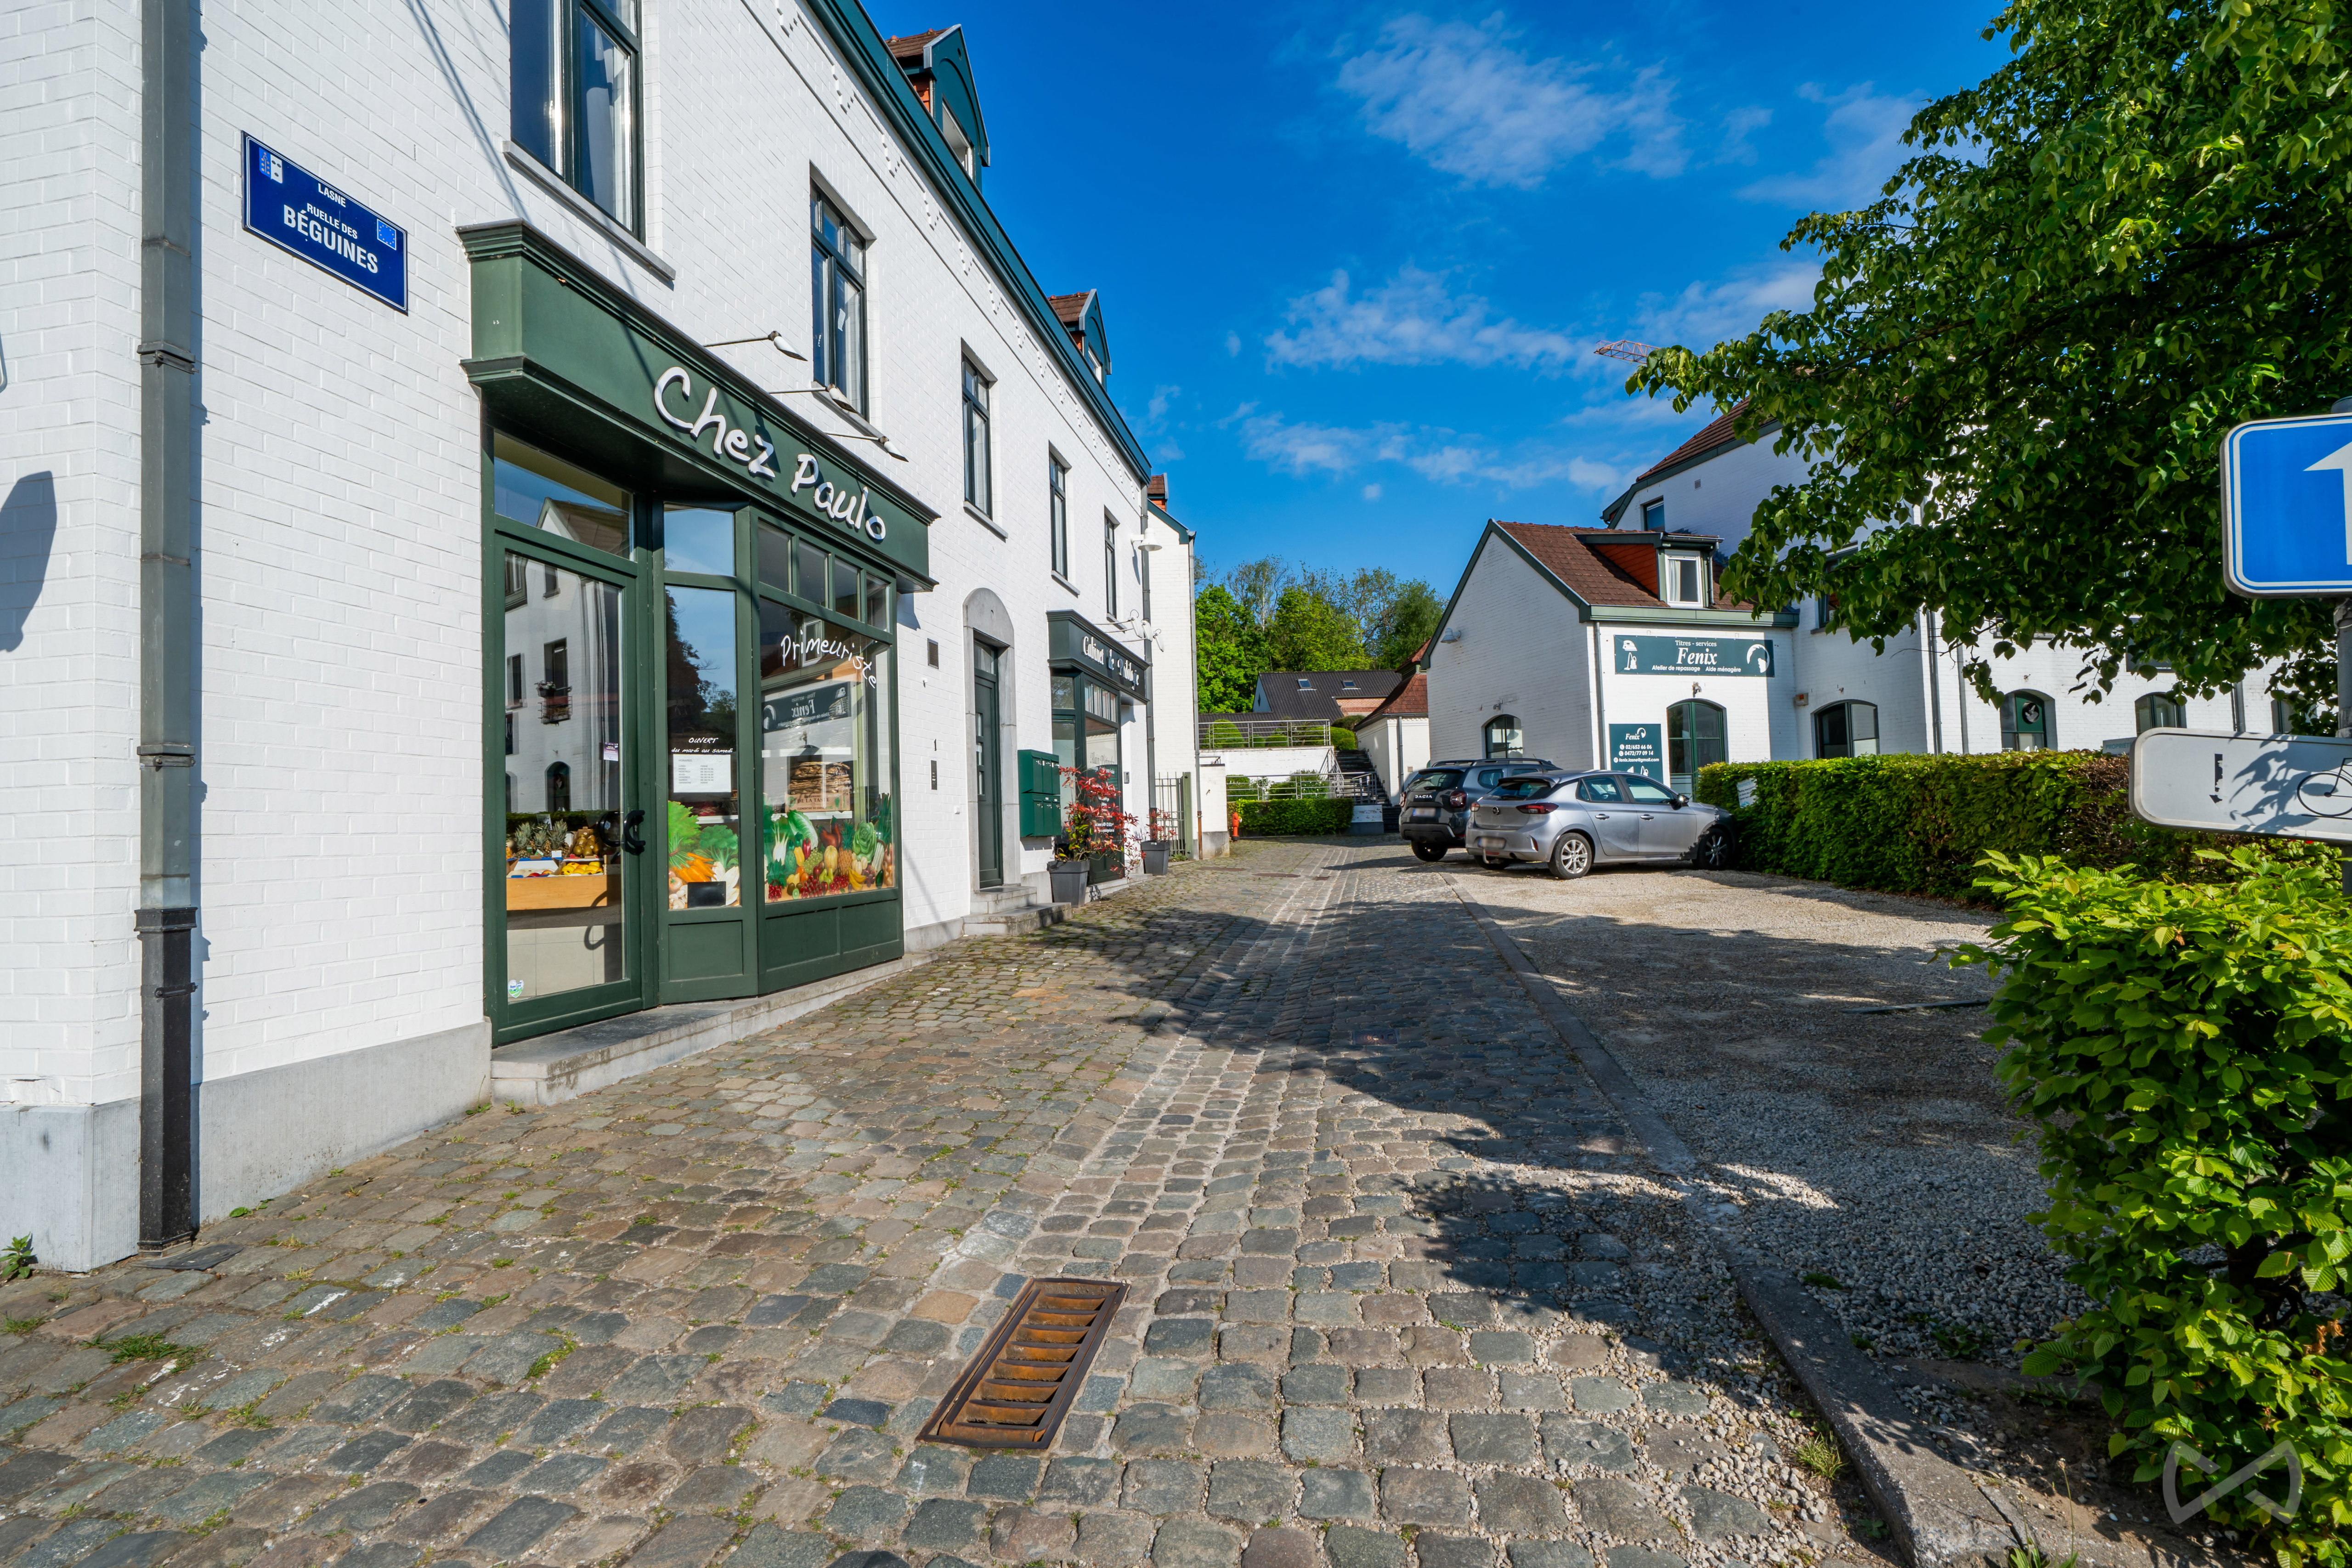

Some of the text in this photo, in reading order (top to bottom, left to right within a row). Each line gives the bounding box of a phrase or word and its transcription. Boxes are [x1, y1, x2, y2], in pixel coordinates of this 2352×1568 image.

[318, 183, 346, 207] LASNE
[284, 204, 378, 273] BÉGUINES
[307, 203, 358, 239] RUELLE DES
[654, 367, 886, 540] Chez Paulo
[780, 629, 877, 689] Primeuriste
[1083, 636, 1104, 665] Cabinet
[1109, 649, 1114, 671] de
[1676, 647, 1718, 665] Fenix
